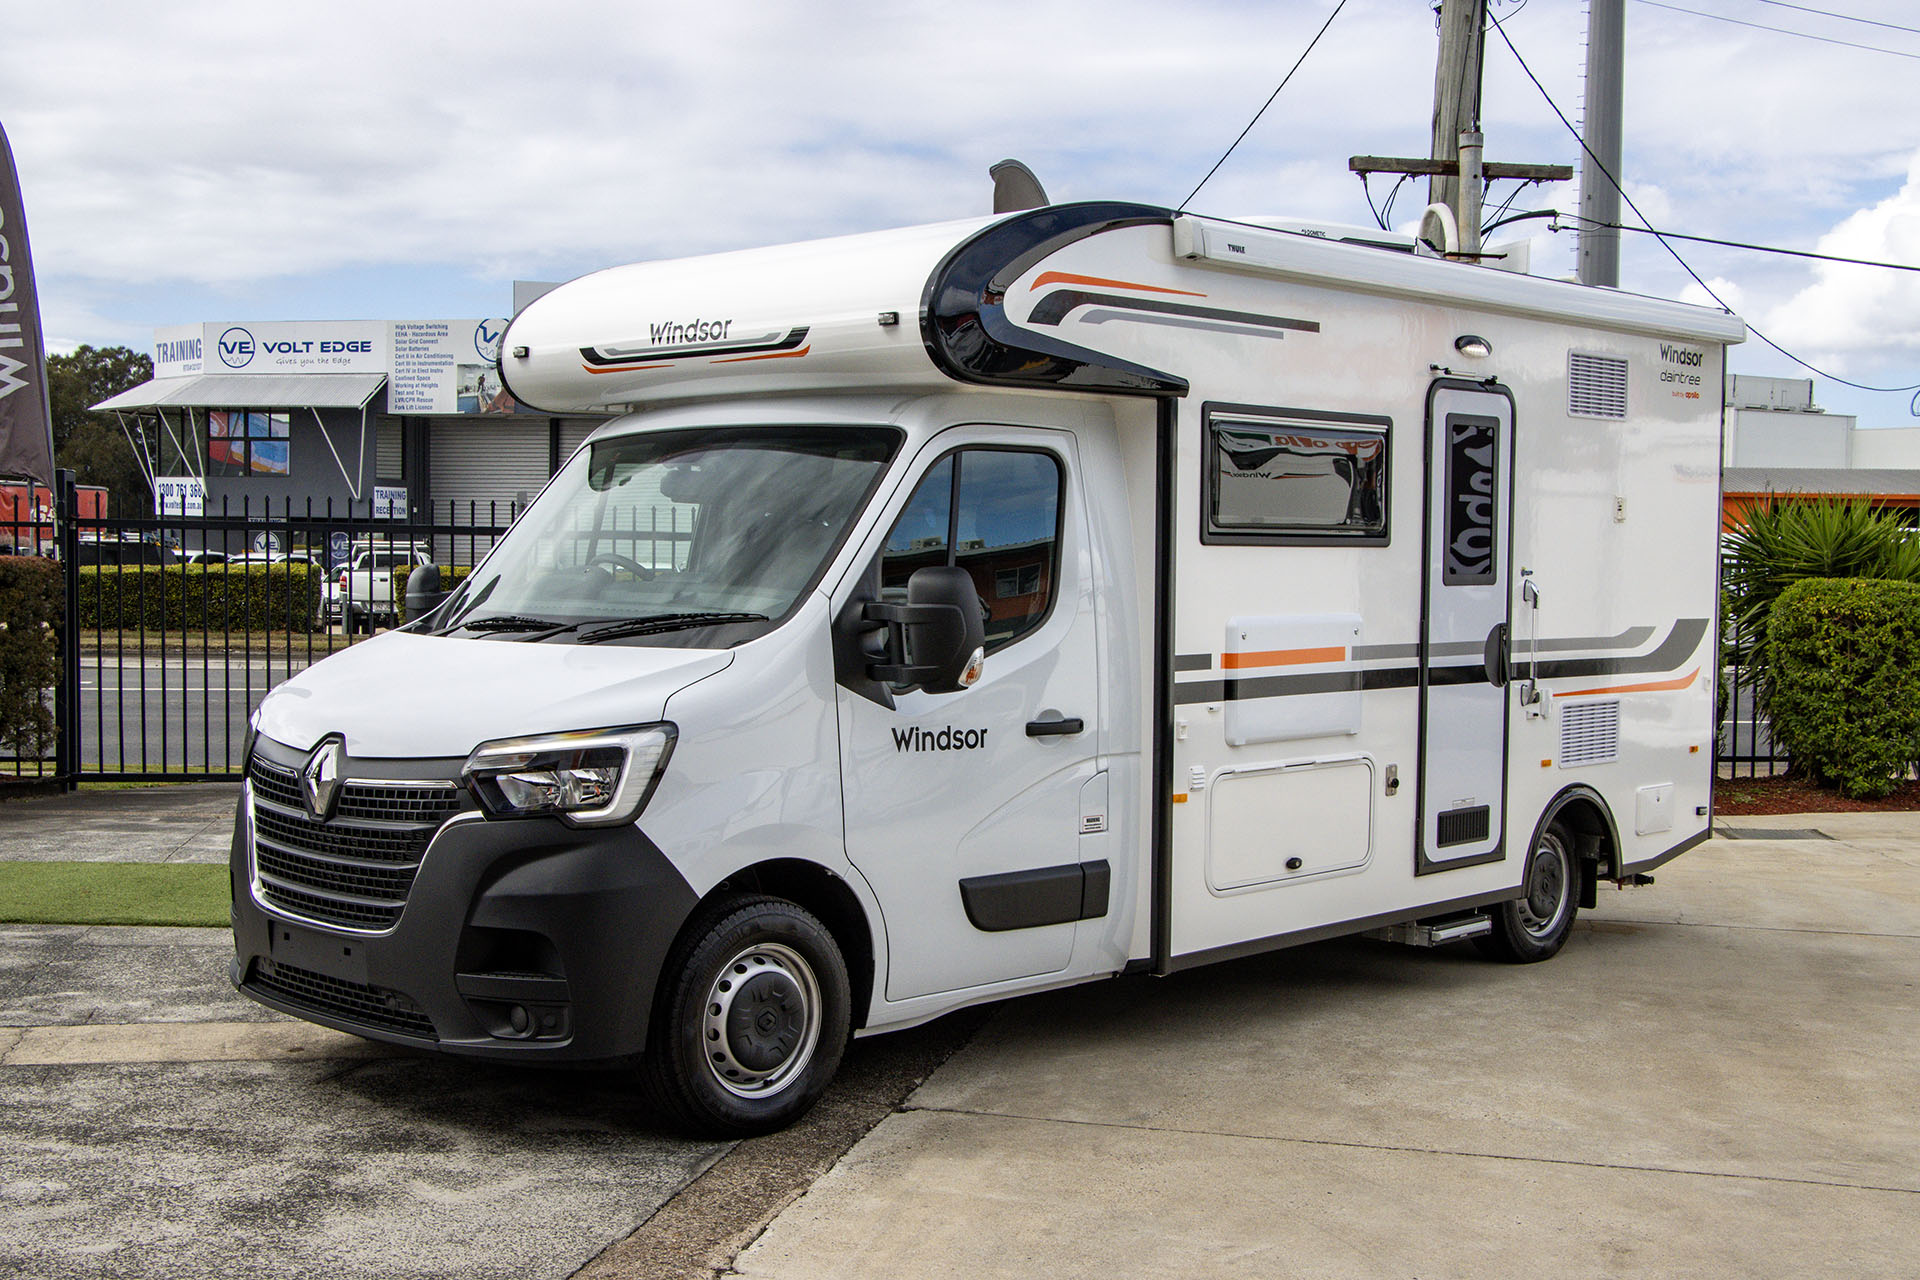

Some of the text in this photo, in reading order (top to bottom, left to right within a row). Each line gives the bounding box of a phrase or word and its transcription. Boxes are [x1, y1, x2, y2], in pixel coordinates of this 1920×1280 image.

[1227, 243, 1246, 254] THULE
[425, 323, 449, 331] Switching
[650, 318, 733, 346] Windsor
[156, 338, 202, 364] TRAINING
[262, 340, 372, 354] VOLT EDGE
[275, 356, 351, 367] Gives you the Edge
[1660, 343, 1704, 367] Windsor
[1660, 370, 1701, 386] daintree
[1685, 391, 1701, 400] apollo
[158, 483, 174, 497] 1300
[176, 483, 187, 497] 761
[375, 490, 407, 500] TRAINING
[375, 506, 407, 515] RECETION
[891, 725, 988, 753] Windsor
